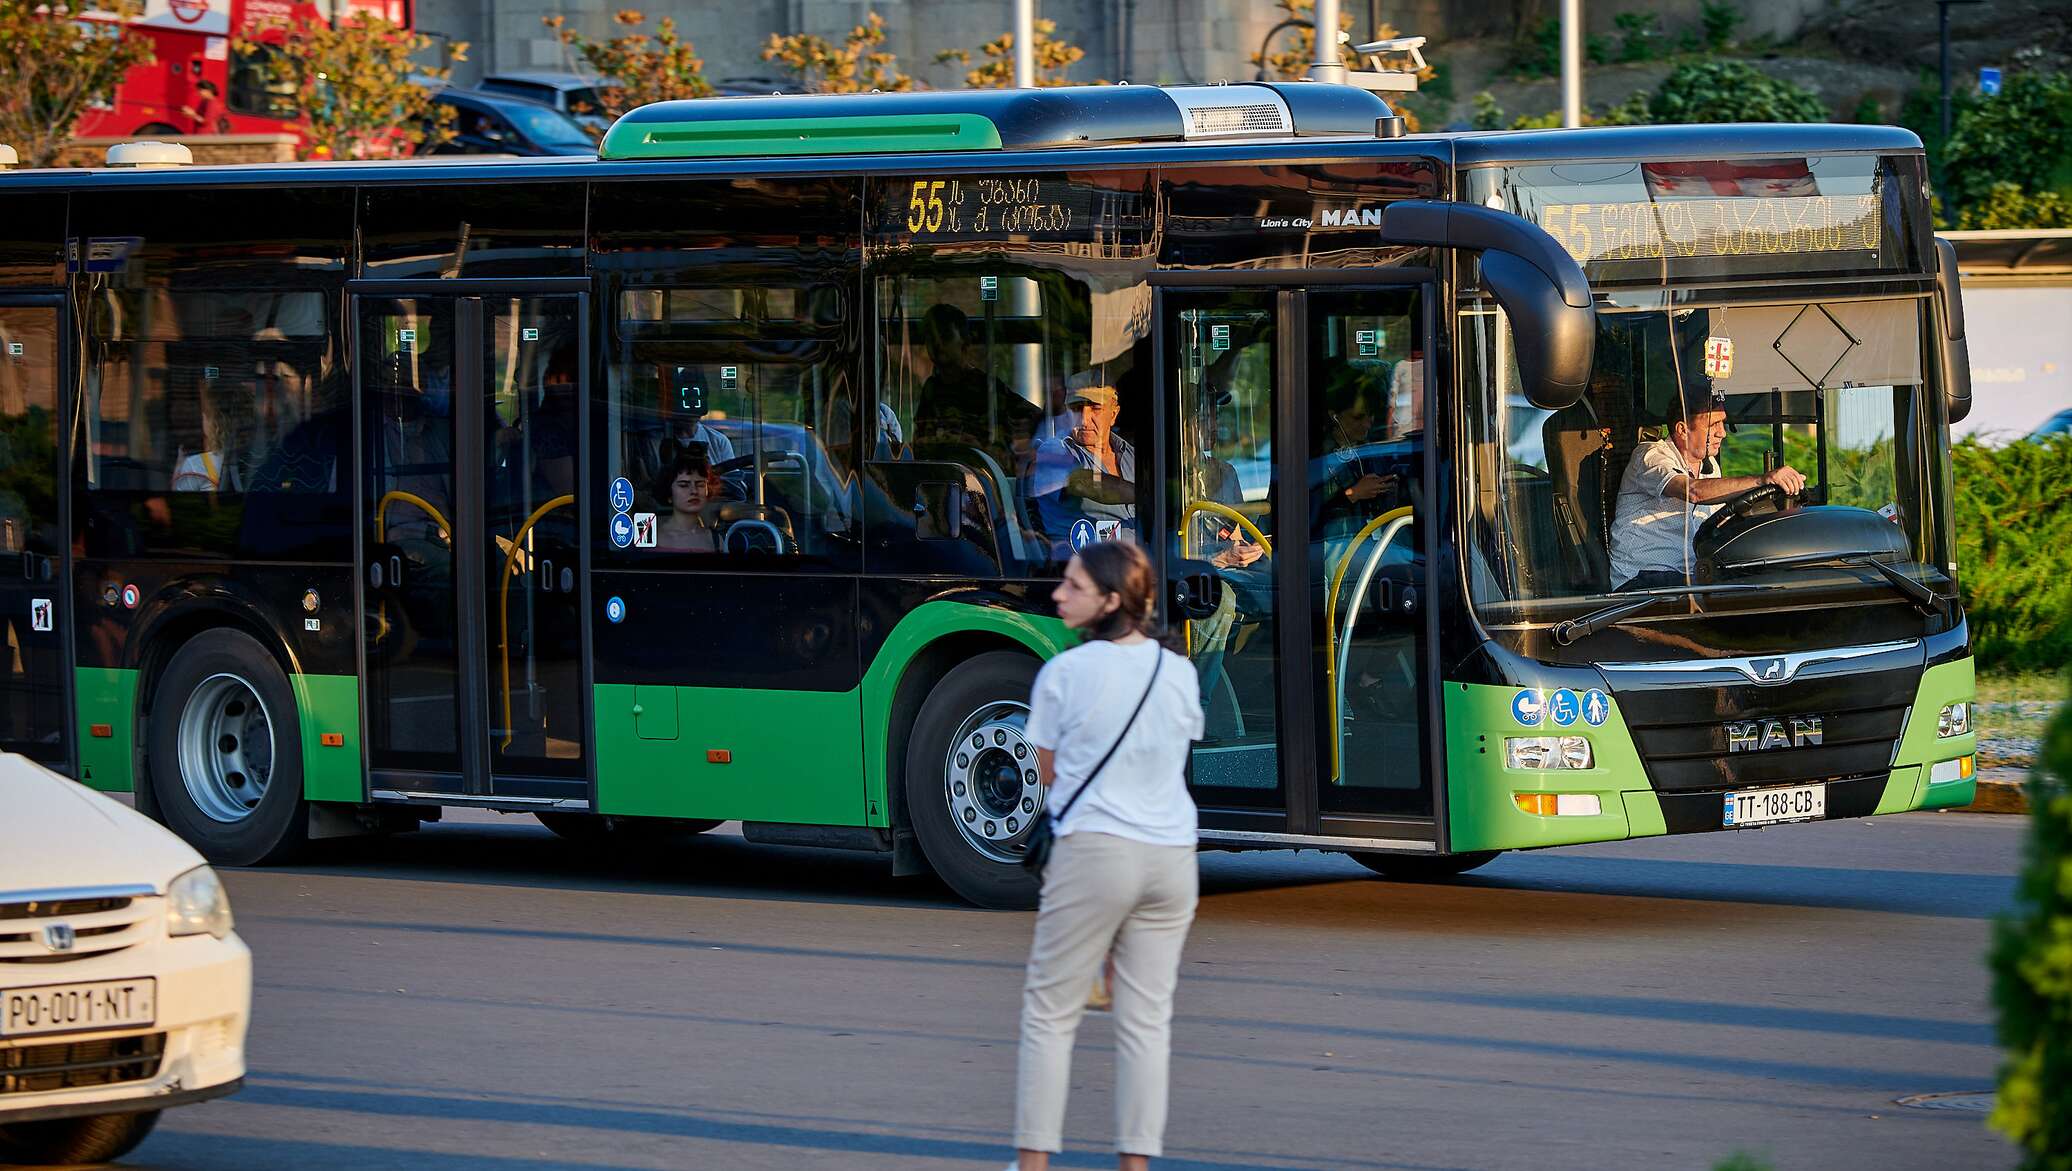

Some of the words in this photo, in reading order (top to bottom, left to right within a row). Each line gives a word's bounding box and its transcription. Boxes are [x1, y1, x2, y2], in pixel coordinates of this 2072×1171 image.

[978, 179, 1039, 205] უბანი
[908, 181, 945, 233] 55
[1321, 208, 1382, 226] MAN
[1260, 218, 1289, 228] Lion's
[1291, 217, 1314, 228] City
[1544, 203, 1593, 260] 55
[1727, 719, 1823, 753] MAN
[1737, 790, 1813, 818] TT-188-CB
